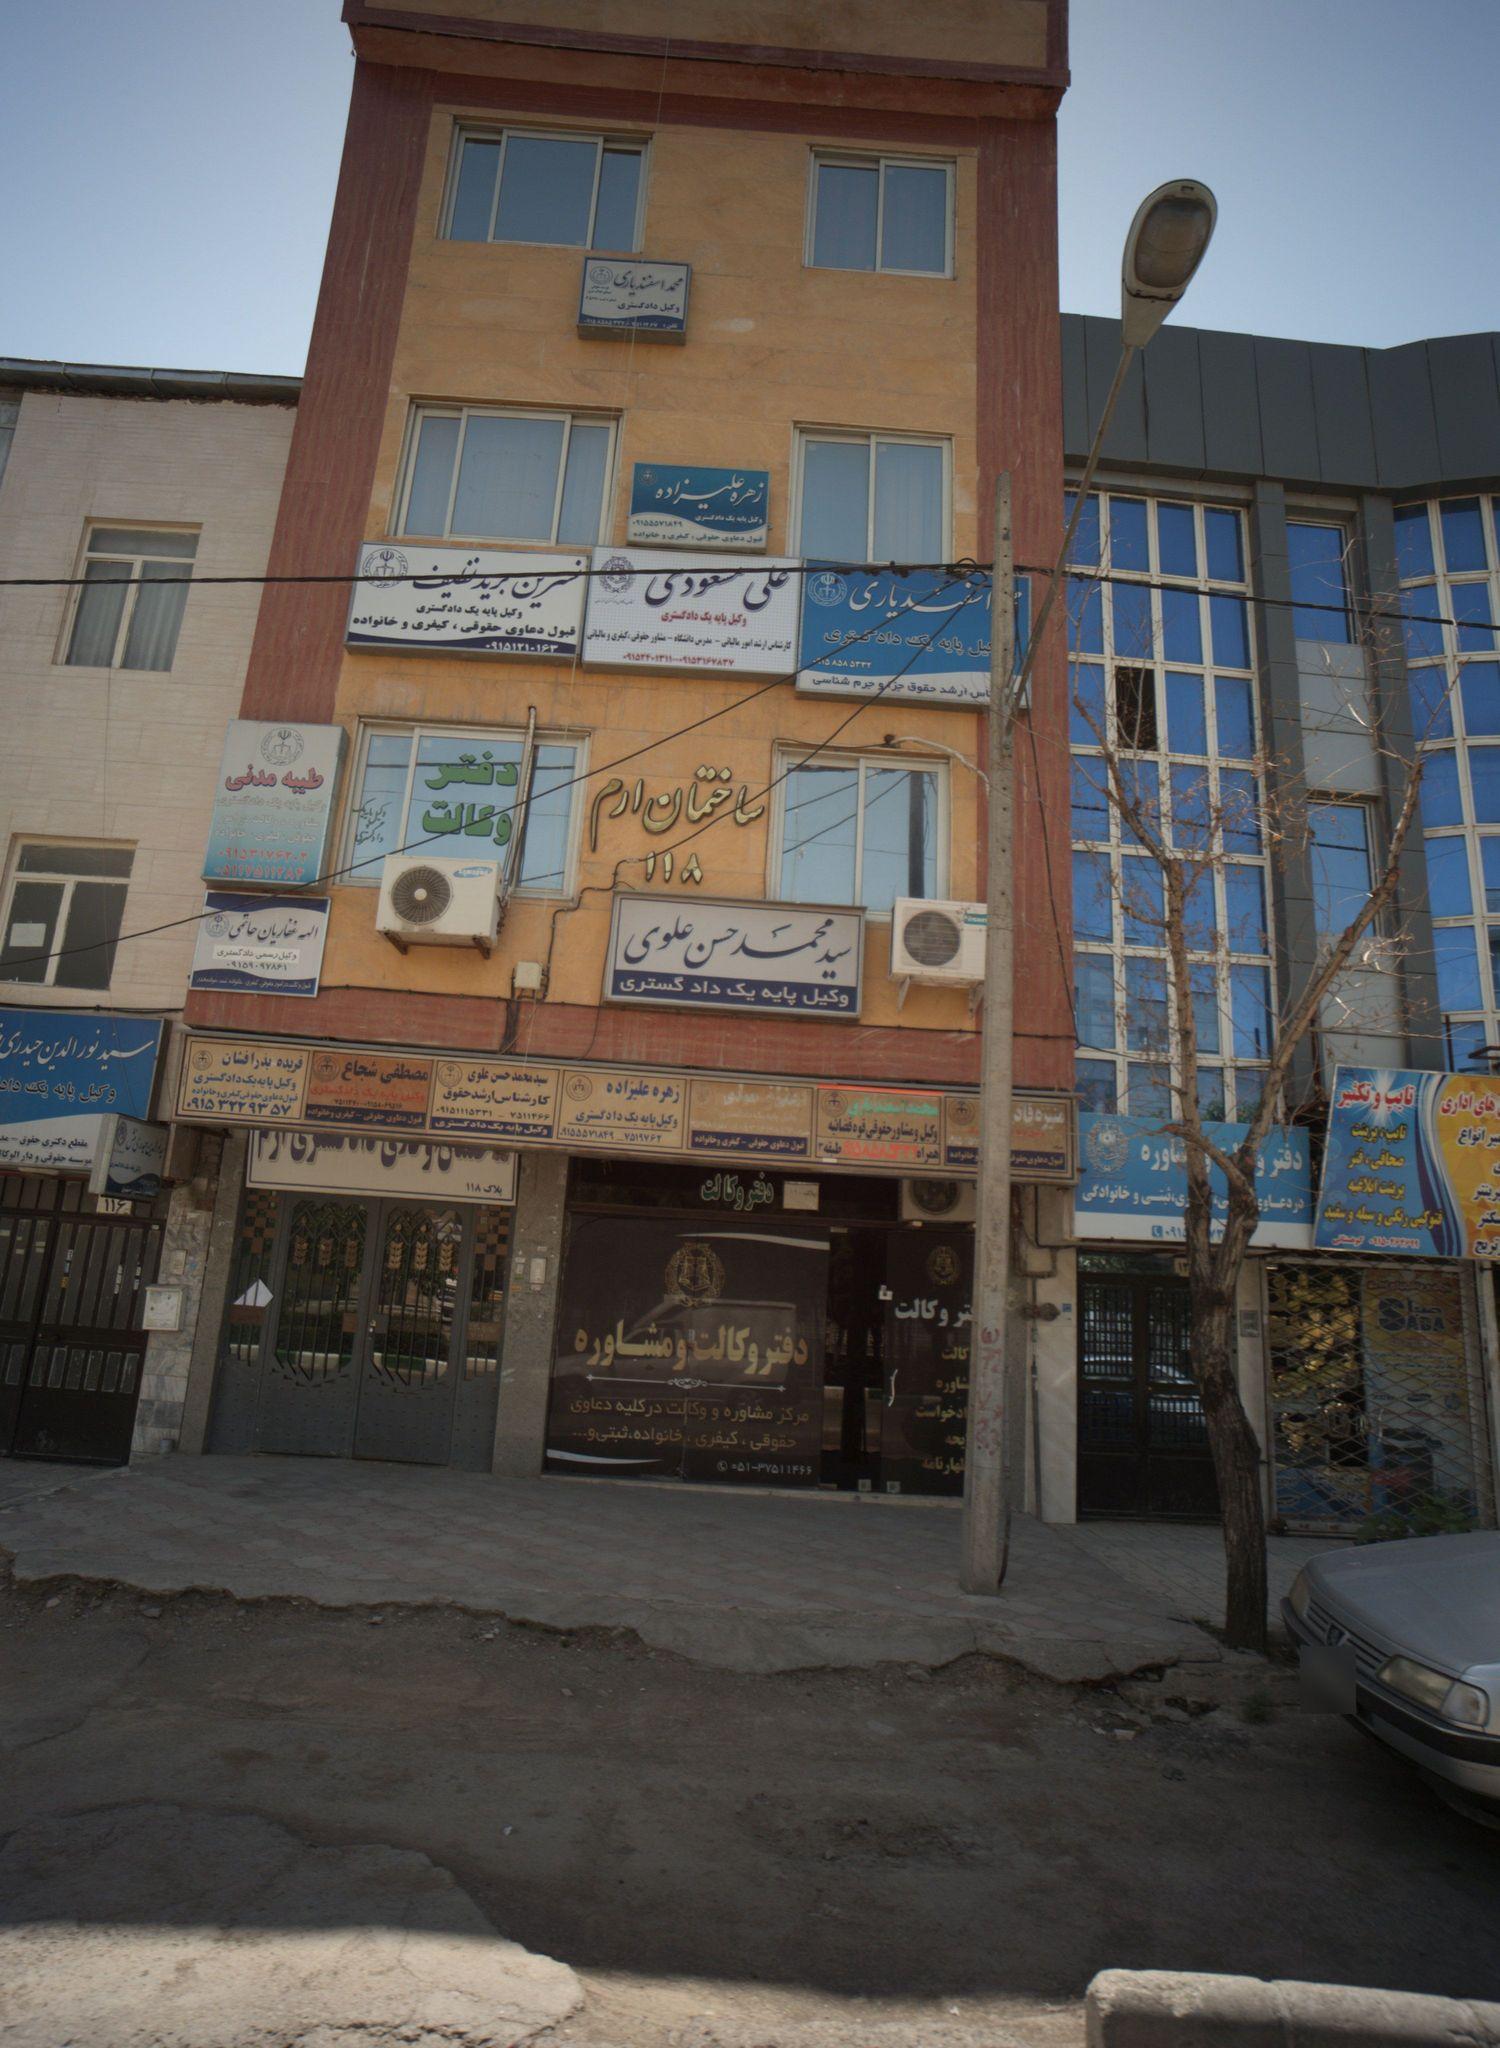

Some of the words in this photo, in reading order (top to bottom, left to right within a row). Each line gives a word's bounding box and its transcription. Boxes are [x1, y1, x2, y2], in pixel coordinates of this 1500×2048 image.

[660, 302, 680, 313] وکیل
[655, 473, 745, 510] علیزاده
[730, 480, 765, 506] زهره
[747, 515, 763, 525] وکیل
[512, 559, 583, 608] نسرین
[645, 566, 745, 608] مسعودی
[743, 565, 791, 612] علی
[416, 603, 462, 614] دادگستری
[465, 605, 479, 615] یک
[481, 606, 498, 617] پایه
[500, 607, 523, 619] وکیل
[661, 609, 699, 622] دادگستری
[700, 610, 712, 622] یک
[353, 614, 398, 627] خانواده
[411, 619, 449, 631] کیفری
[713, 612, 727, 624] پایه
[729, 613, 747, 627] وکیل
[460, 622, 502, 634] حقوقی
[505, 624, 544, 637] دعاوی
[548, 626, 576, 638] قبول
[907, 634, 933, 651] یک
[938, 638, 963, 656] پایه
[812, 676, 850, 687] شناسی
[853, 680, 875, 690] جرم
[907, 682, 936, 694] حقوق
[939, 682, 968, 698] ارشد
[225, 764, 277, 792] مدنی
[424, 750, 518, 790] دفتر
[281, 767, 324, 795] طیبه
[642, 764, 765, 836] ساختمان
[422, 800, 513, 847] وکالت
[590, 778, 646, 854] ارم
[645, 851, 704, 884] ۱۱۸
[257, 918, 299, 945] غفاریان
[297, 924, 319, 940] الهه
[623, 914, 694, 965] علوی
[728, 918, 835, 960] محمد
[683, 926, 739, 969] حسن
[255, 952, 279, 961] رسمی
[278, 951, 297, 962] وکیل
[815, 946, 852, 980] سید
[727, 982, 755, 1001] یک
[761, 986, 797, 1006] پایه
[802, 987, 849, 1008] وکیل
[97, 1031, 154, 1071] سید
[276, 1055, 303, 1073] فریده
[341, 1059, 378, 1081] شجاع
[193, 1072, 242, 1084] دادگستری
[242, 1074, 257, 1087] یک
[380, 1062, 429, 1084] مصطفی
[467, 1067, 489, 1083] علوی
[490, 1071, 511, 1084] حسن
[512, 1071, 534, 1083] محمد
[533, 1074, 550, 1087] سید
[25, 1080, 49, 1099] یک
[256, 1076, 273, 1089] پایه
[273, 1077, 297, 1091] وکیل
[606, 1079, 649, 1101] علیزاده
[53, 1082, 75, 1102] پایه
[79, 1084, 117, 1104] وکیل
[443, 1087, 472, 1102] حقوق
[471, 1089, 496, 1103] ارشد
[494, 1092, 551, 1107] کارشناس
[652, 1084, 680, 1104] زهره
[1337, 1081, 1371, 1107] تکثیر
[1373, 1090, 1381, 1110] و
[1384, 1084, 1416, 1110] تایپ
[186, 1096, 215, 1110] ۰۹۱۵
[1440, 1093, 1473, 1115] اداری
[434, 1119, 488, 1129] دادگستری
[576, 1109, 624, 1123] دادگستری
[624, 1111, 640, 1127] یک
[639, 1113, 657, 1128] پایه
[656, 1114, 679, 1129] وکیل
[488, 1122, 504, 1131] یک
[506, 1124, 524, 1135] پایه
[523, 1125, 548, 1137] وکیل
[865, 1120, 892, 1139] حقوقی
[919, 1120, 938, 1144] وکیل
[41, 1137, 67, 1147] دکتری
[67, 1138, 88, 1149] مقطع
[1458, 1127, 1486, 1146] انواع
[823, 1141, 843, 1155] طبقه
[916, 1146, 939, 1163] همراه
[40, 1152, 66, 1164] حقوقی
[1269, 1143, 1302, 1178] دفتر
[466, 1182, 482, 1192] ۱۱۸
[483, 1182, 504, 1194] پلاک
[701, 1173, 746, 1211] وکالت
[744, 1171, 775, 1211] دفتر
[1082, 1185, 1131, 1204] خانوادگی
[104, 1198, 126, 1213] ۱۱۶
[895, 1297, 949, 1328] وکالت
[574, 1319, 673, 1367] مشاوره
[692, 1324, 758, 1375] وکالت
[758, 1325, 809, 1376] دفتر
[569, 1396, 612, 1414] دعاوی
[666, 1400, 707, 1421] وکالت
[723, 1403, 774, 1424] مشاوره
[778, 1408, 809, 1425] مرکز
[695, 1430, 738, 1448] کیفری
[750, 1434, 797, 1451] حقوقی
